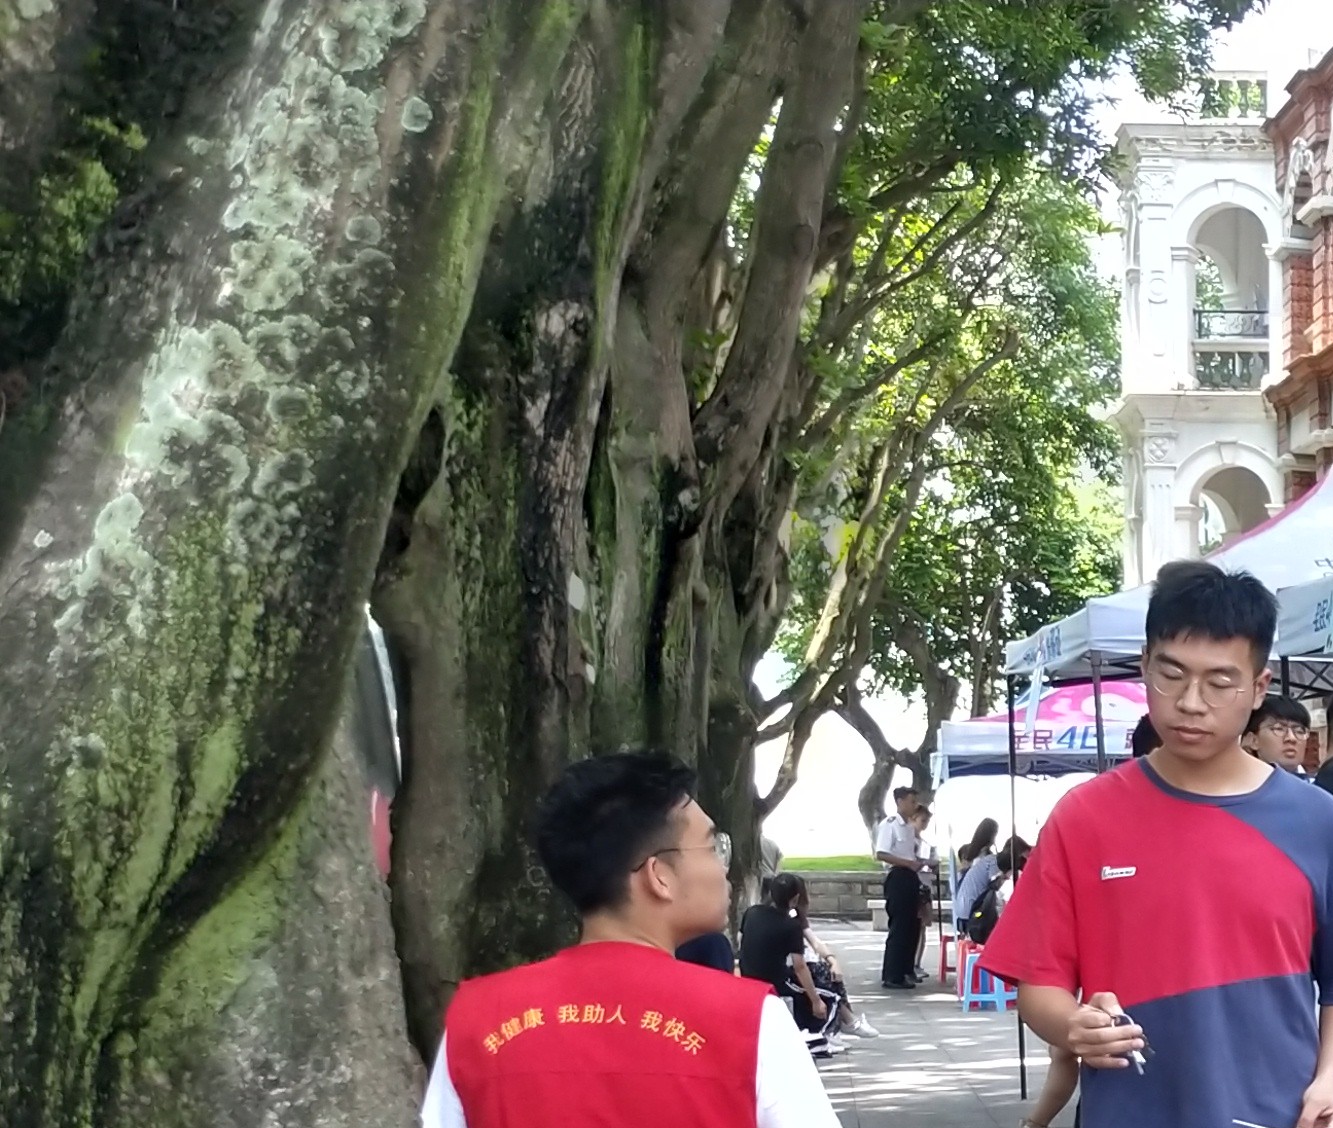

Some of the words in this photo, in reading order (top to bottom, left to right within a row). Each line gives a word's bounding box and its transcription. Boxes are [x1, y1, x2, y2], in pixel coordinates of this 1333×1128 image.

[483, 1007, 546, 1055] 我健康
[558, 1004, 627, 1025] 我助人
[640, 1010, 706, 1055] 我快乐
